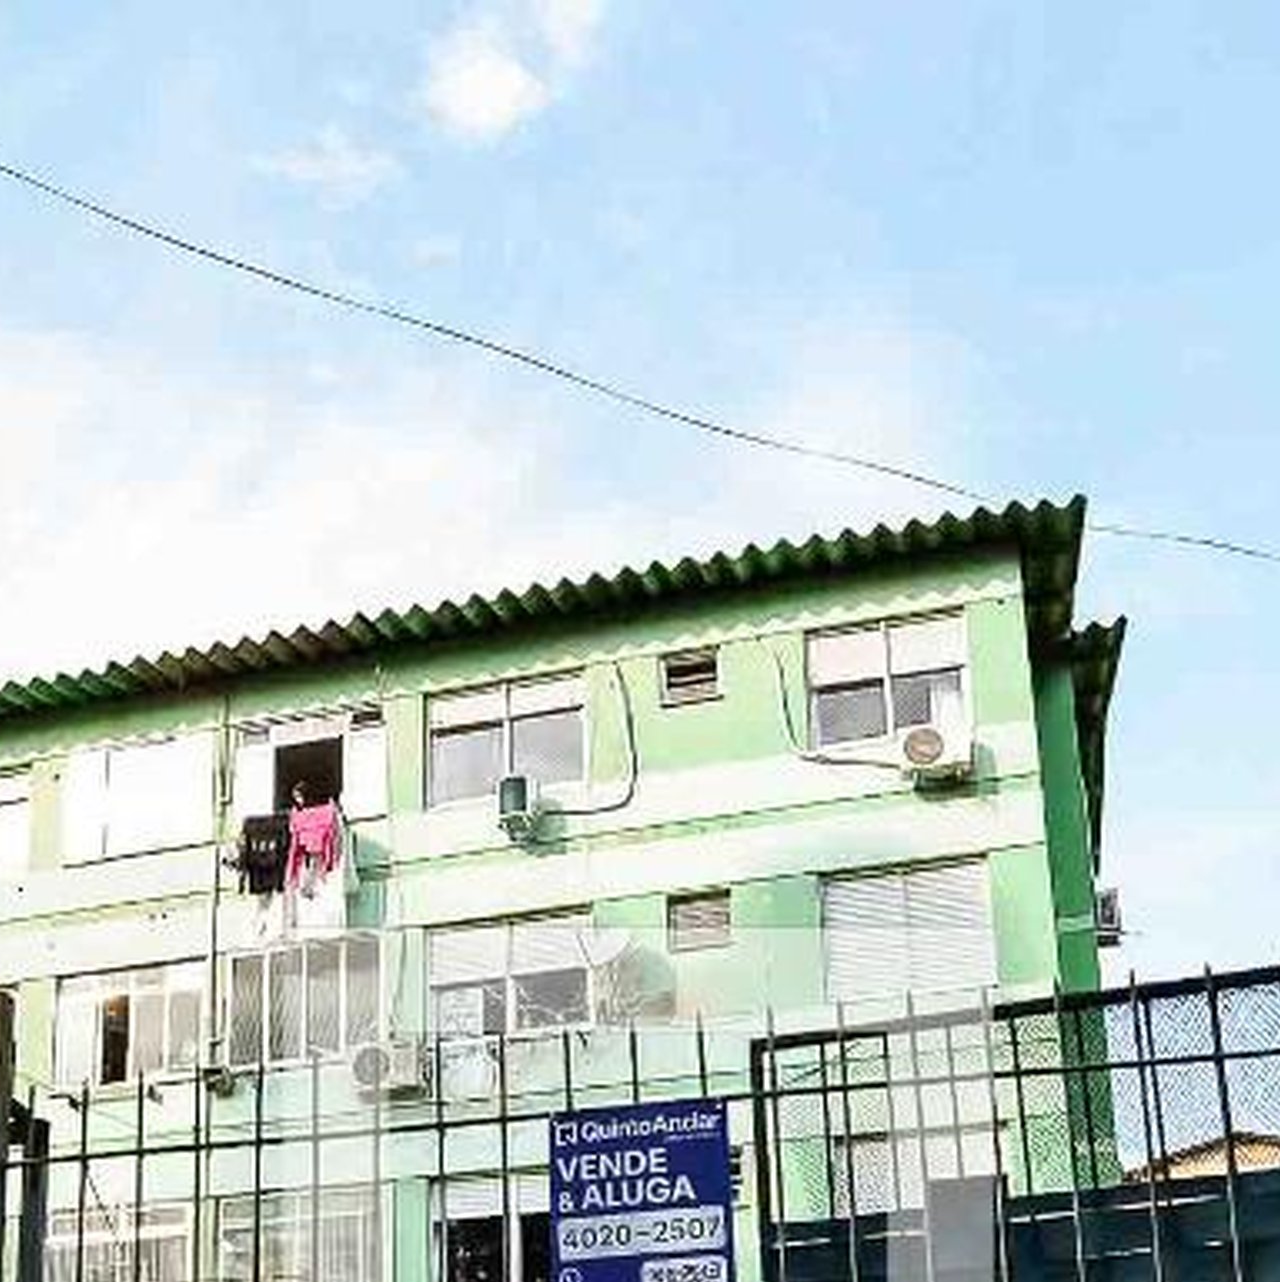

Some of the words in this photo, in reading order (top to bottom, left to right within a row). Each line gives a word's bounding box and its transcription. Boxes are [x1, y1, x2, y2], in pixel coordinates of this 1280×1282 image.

[580, 1111, 721, 1142] QuintoAndar
[556, 1148, 668, 1182] VENDE
[558, 1191, 574, 1213] &
[581, 1174, 697, 1210] ALUGA
[562, 1218, 720, 1250] 4020-2507
